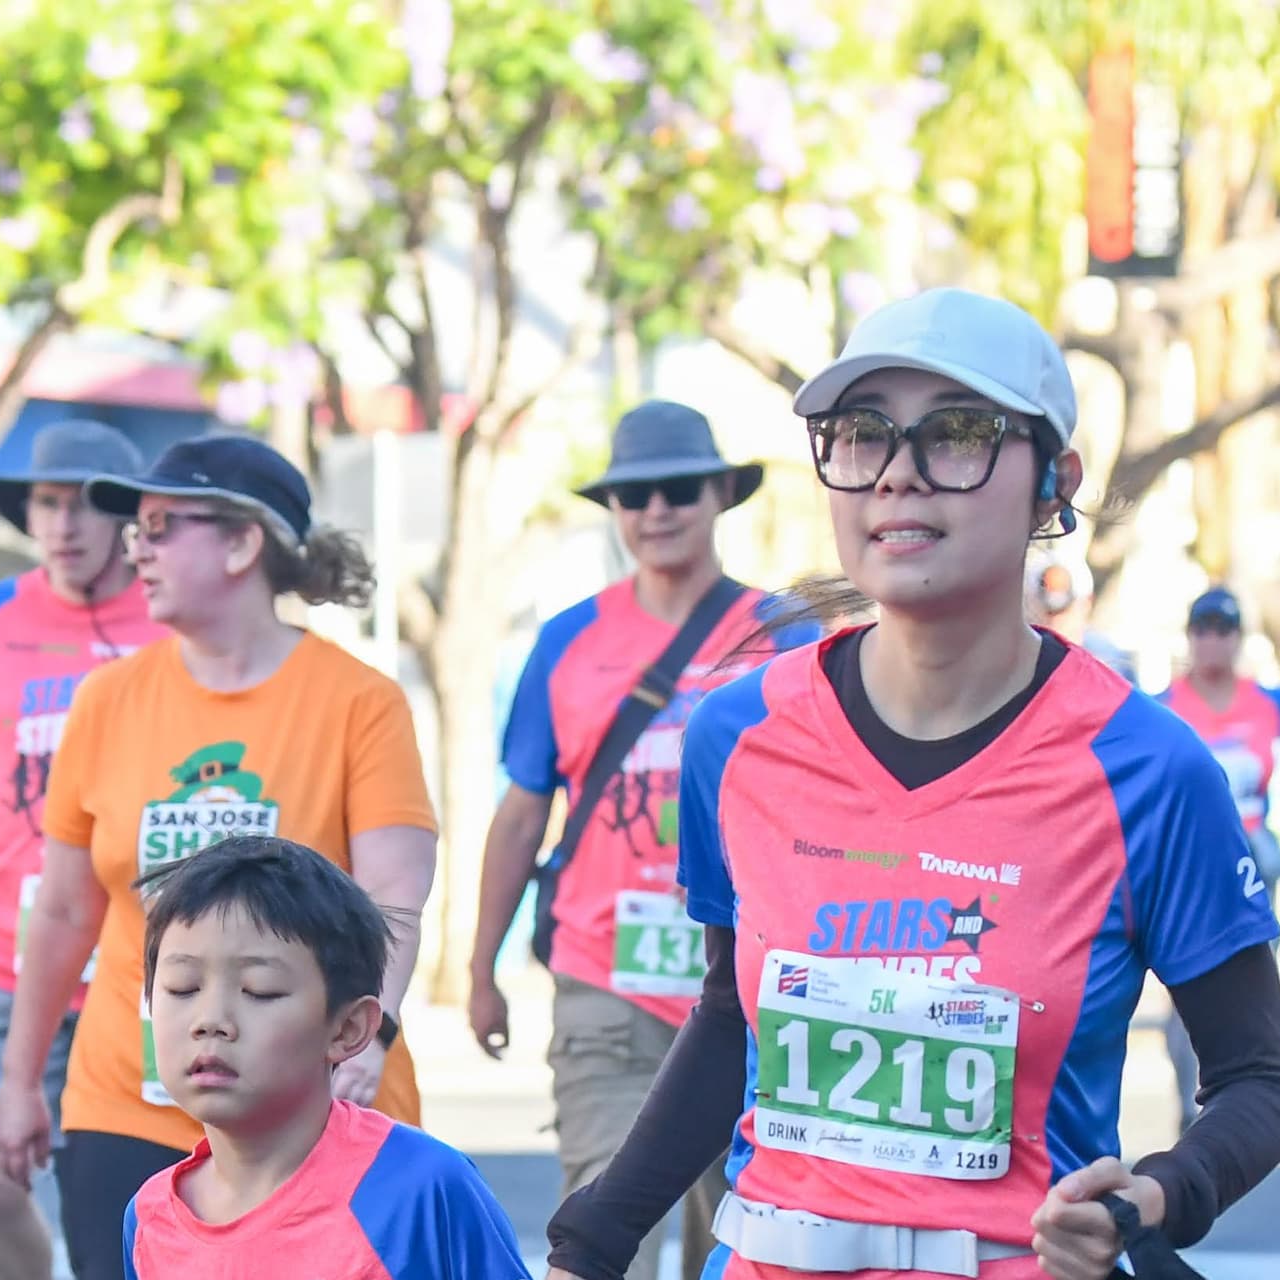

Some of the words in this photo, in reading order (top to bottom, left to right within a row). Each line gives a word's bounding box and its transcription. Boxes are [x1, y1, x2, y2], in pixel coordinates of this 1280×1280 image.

[21, 673, 87, 715] STA
[149, 811, 197, 826] SAN
[207, 810, 270, 826] JOSE
[918, 851, 997, 882] TARANA
[809, 897, 952, 951] STARS
[953, 915, 983, 934] AND
[869, 989, 897, 1014] 5K
[777, 1019, 996, 1133] 1219
[768, 1121, 807, 1142] DRINK
[956, 1151, 998, 1170] 1219
